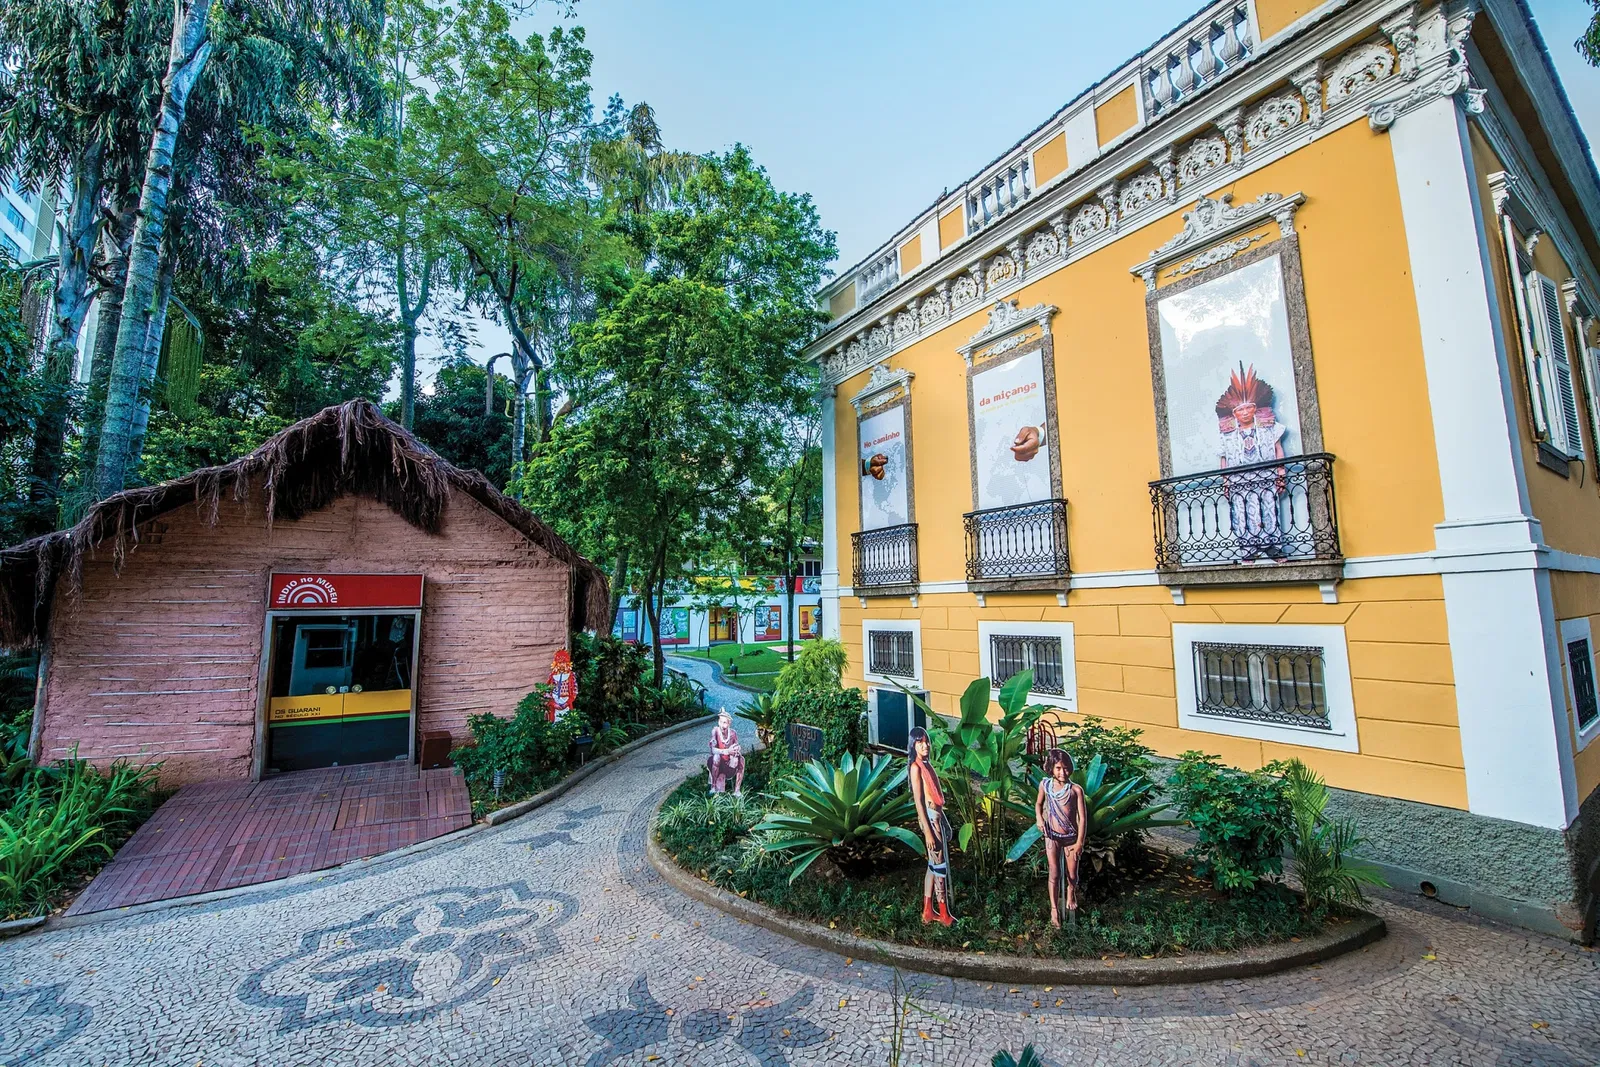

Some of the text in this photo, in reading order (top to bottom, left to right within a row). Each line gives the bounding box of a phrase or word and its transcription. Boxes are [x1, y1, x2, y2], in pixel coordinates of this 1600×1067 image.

[979, 398, 991, 407] da
[993, 382, 1037, 402] miçanga
[873, 431, 900, 446] caminho
[276, 580, 298, 603] ÍNDIO
[316, 577, 338, 603] MUSEU
[791, 724, 818, 742] MUSEU
